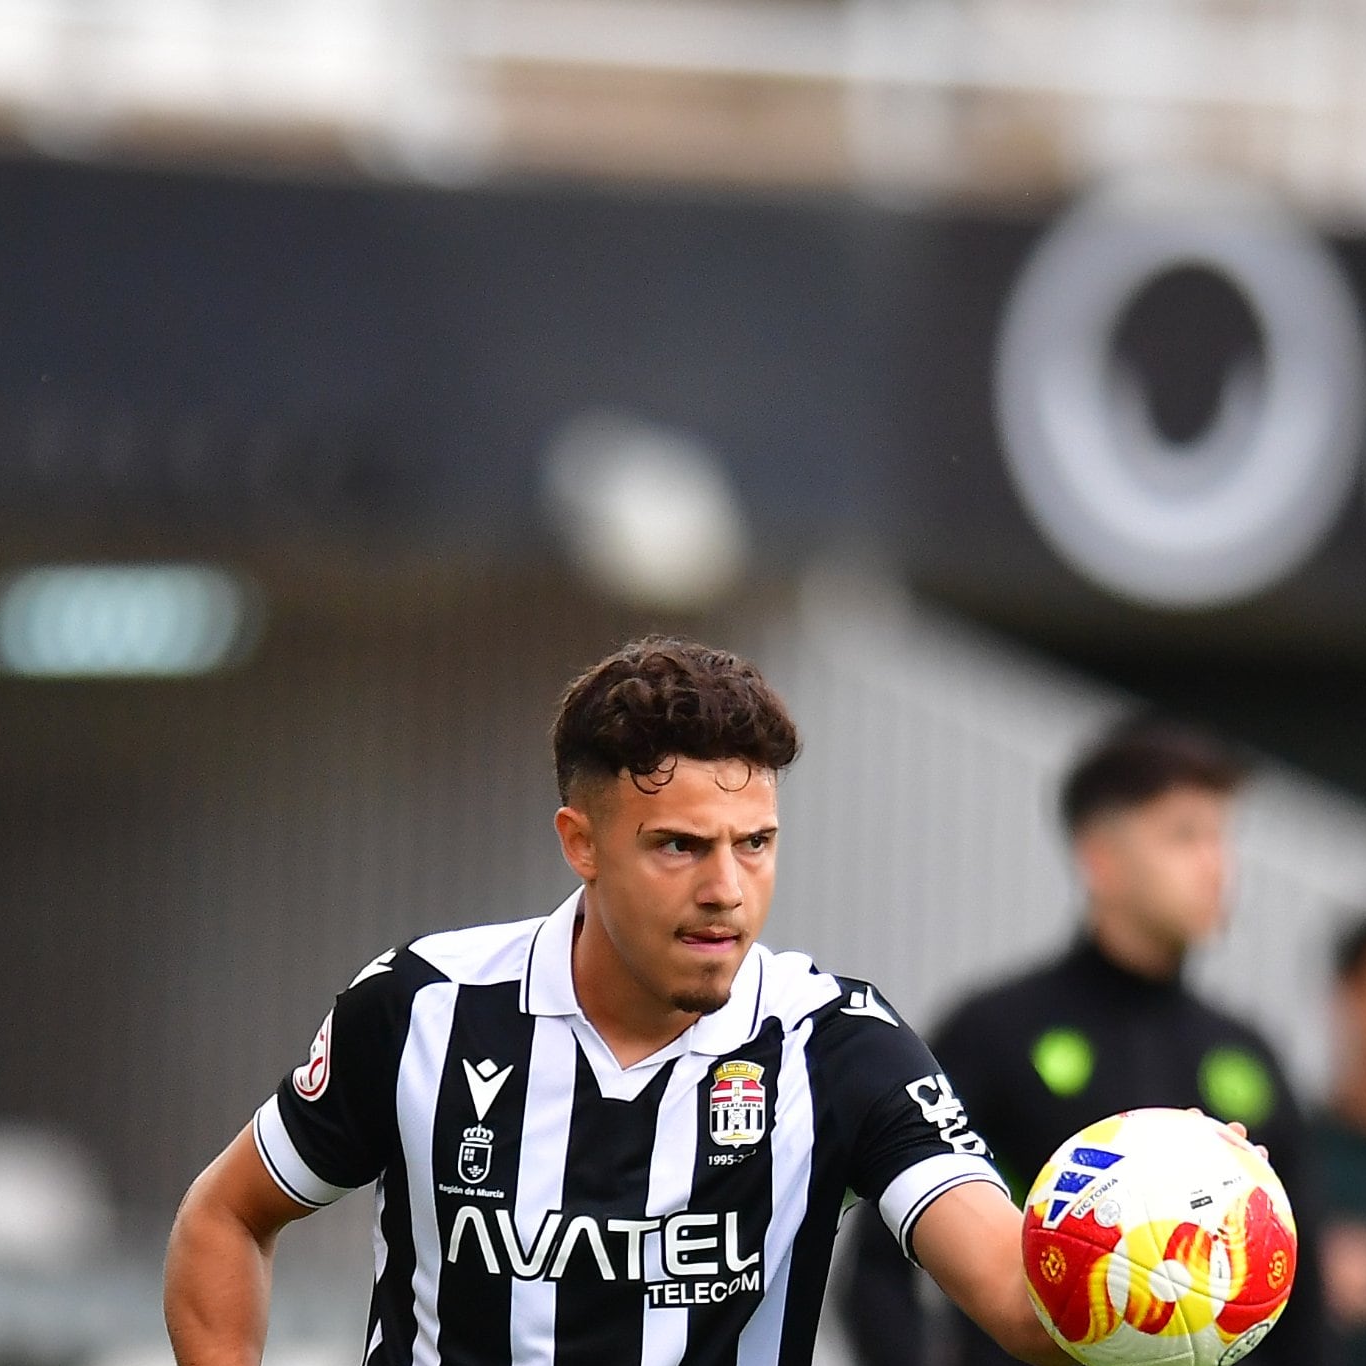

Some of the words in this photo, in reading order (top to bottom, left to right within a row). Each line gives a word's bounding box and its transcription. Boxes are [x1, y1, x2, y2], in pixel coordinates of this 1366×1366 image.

[464, 1186, 475, 1197] de
[476, 1187, 505, 1199] Murcia
[447, 1205, 760, 1281] AVATEL
[647, 1270, 760, 1305] TELECOM
